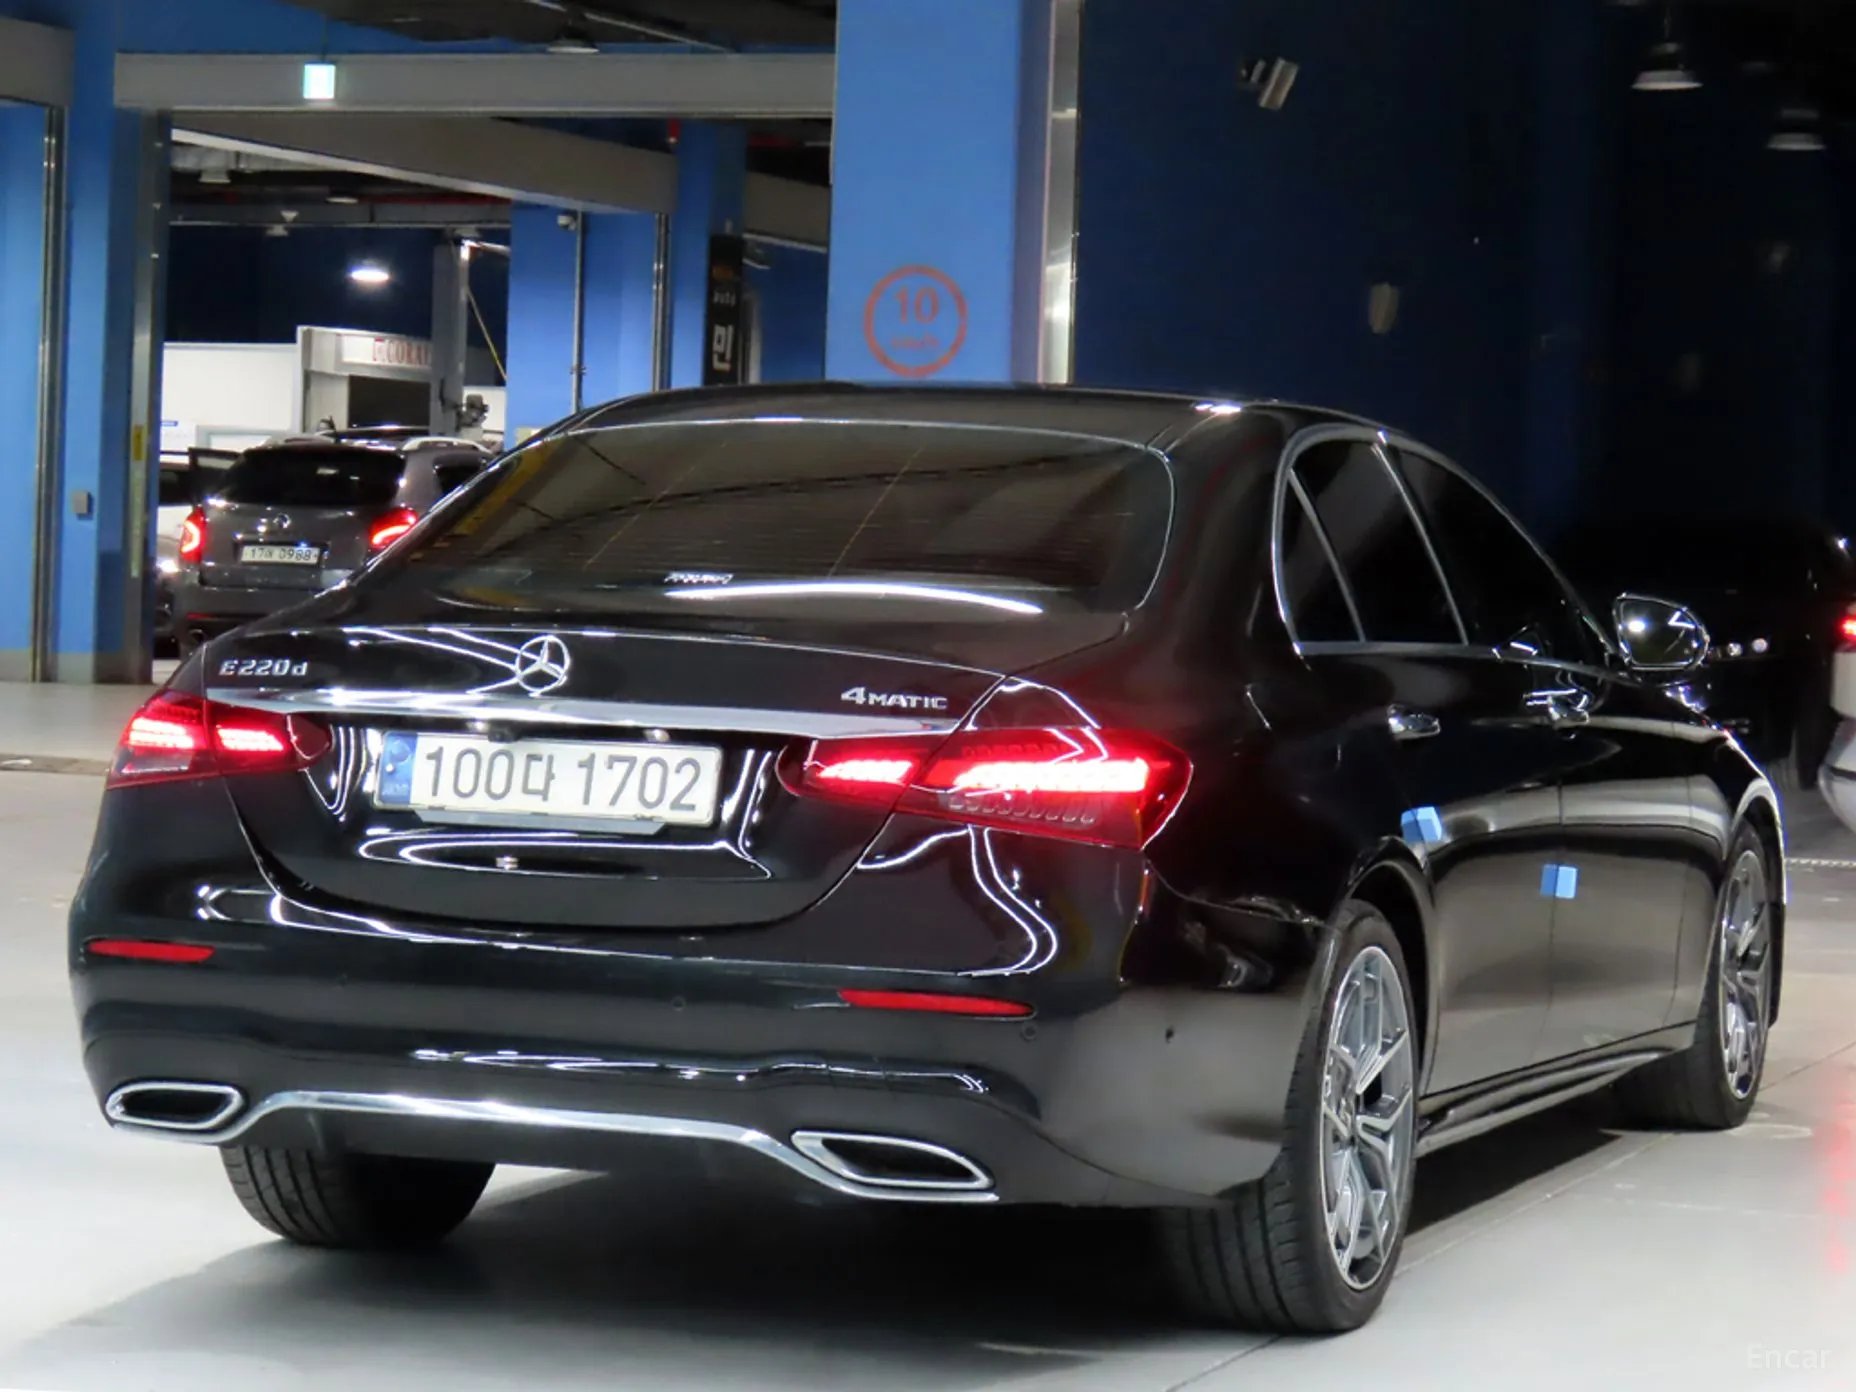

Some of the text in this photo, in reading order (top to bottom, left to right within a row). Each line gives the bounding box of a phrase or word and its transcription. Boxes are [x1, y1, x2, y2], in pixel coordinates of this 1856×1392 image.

[893, 285, 940, 325] 10
[840, 686, 948, 709] 4MATIC
[426, 745, 701, 812] 100다 1702
